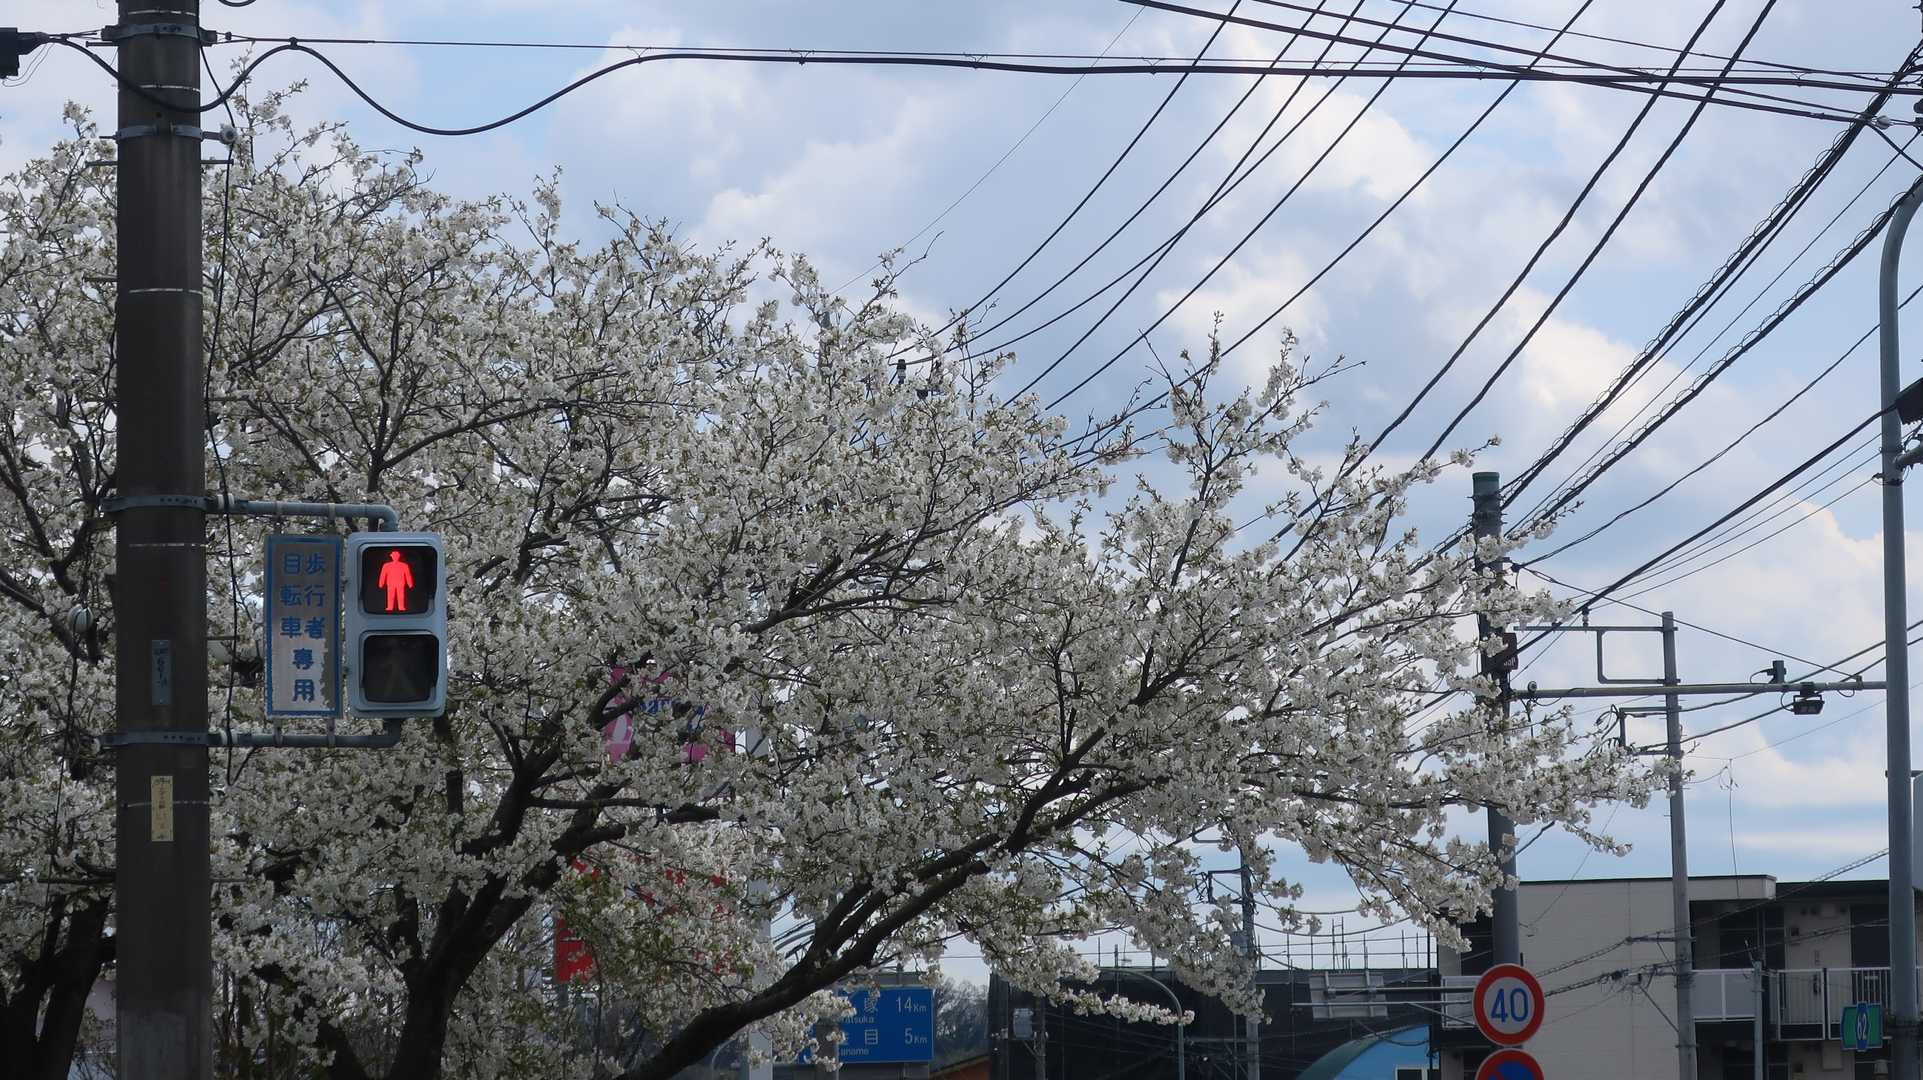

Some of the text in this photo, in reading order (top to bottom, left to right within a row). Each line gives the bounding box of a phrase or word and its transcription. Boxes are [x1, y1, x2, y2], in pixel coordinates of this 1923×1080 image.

[304, 552, 326, 640] 歩行者
[292, 647, 315, 703] 専用
[1490, 987, 1529, 1023] 40
